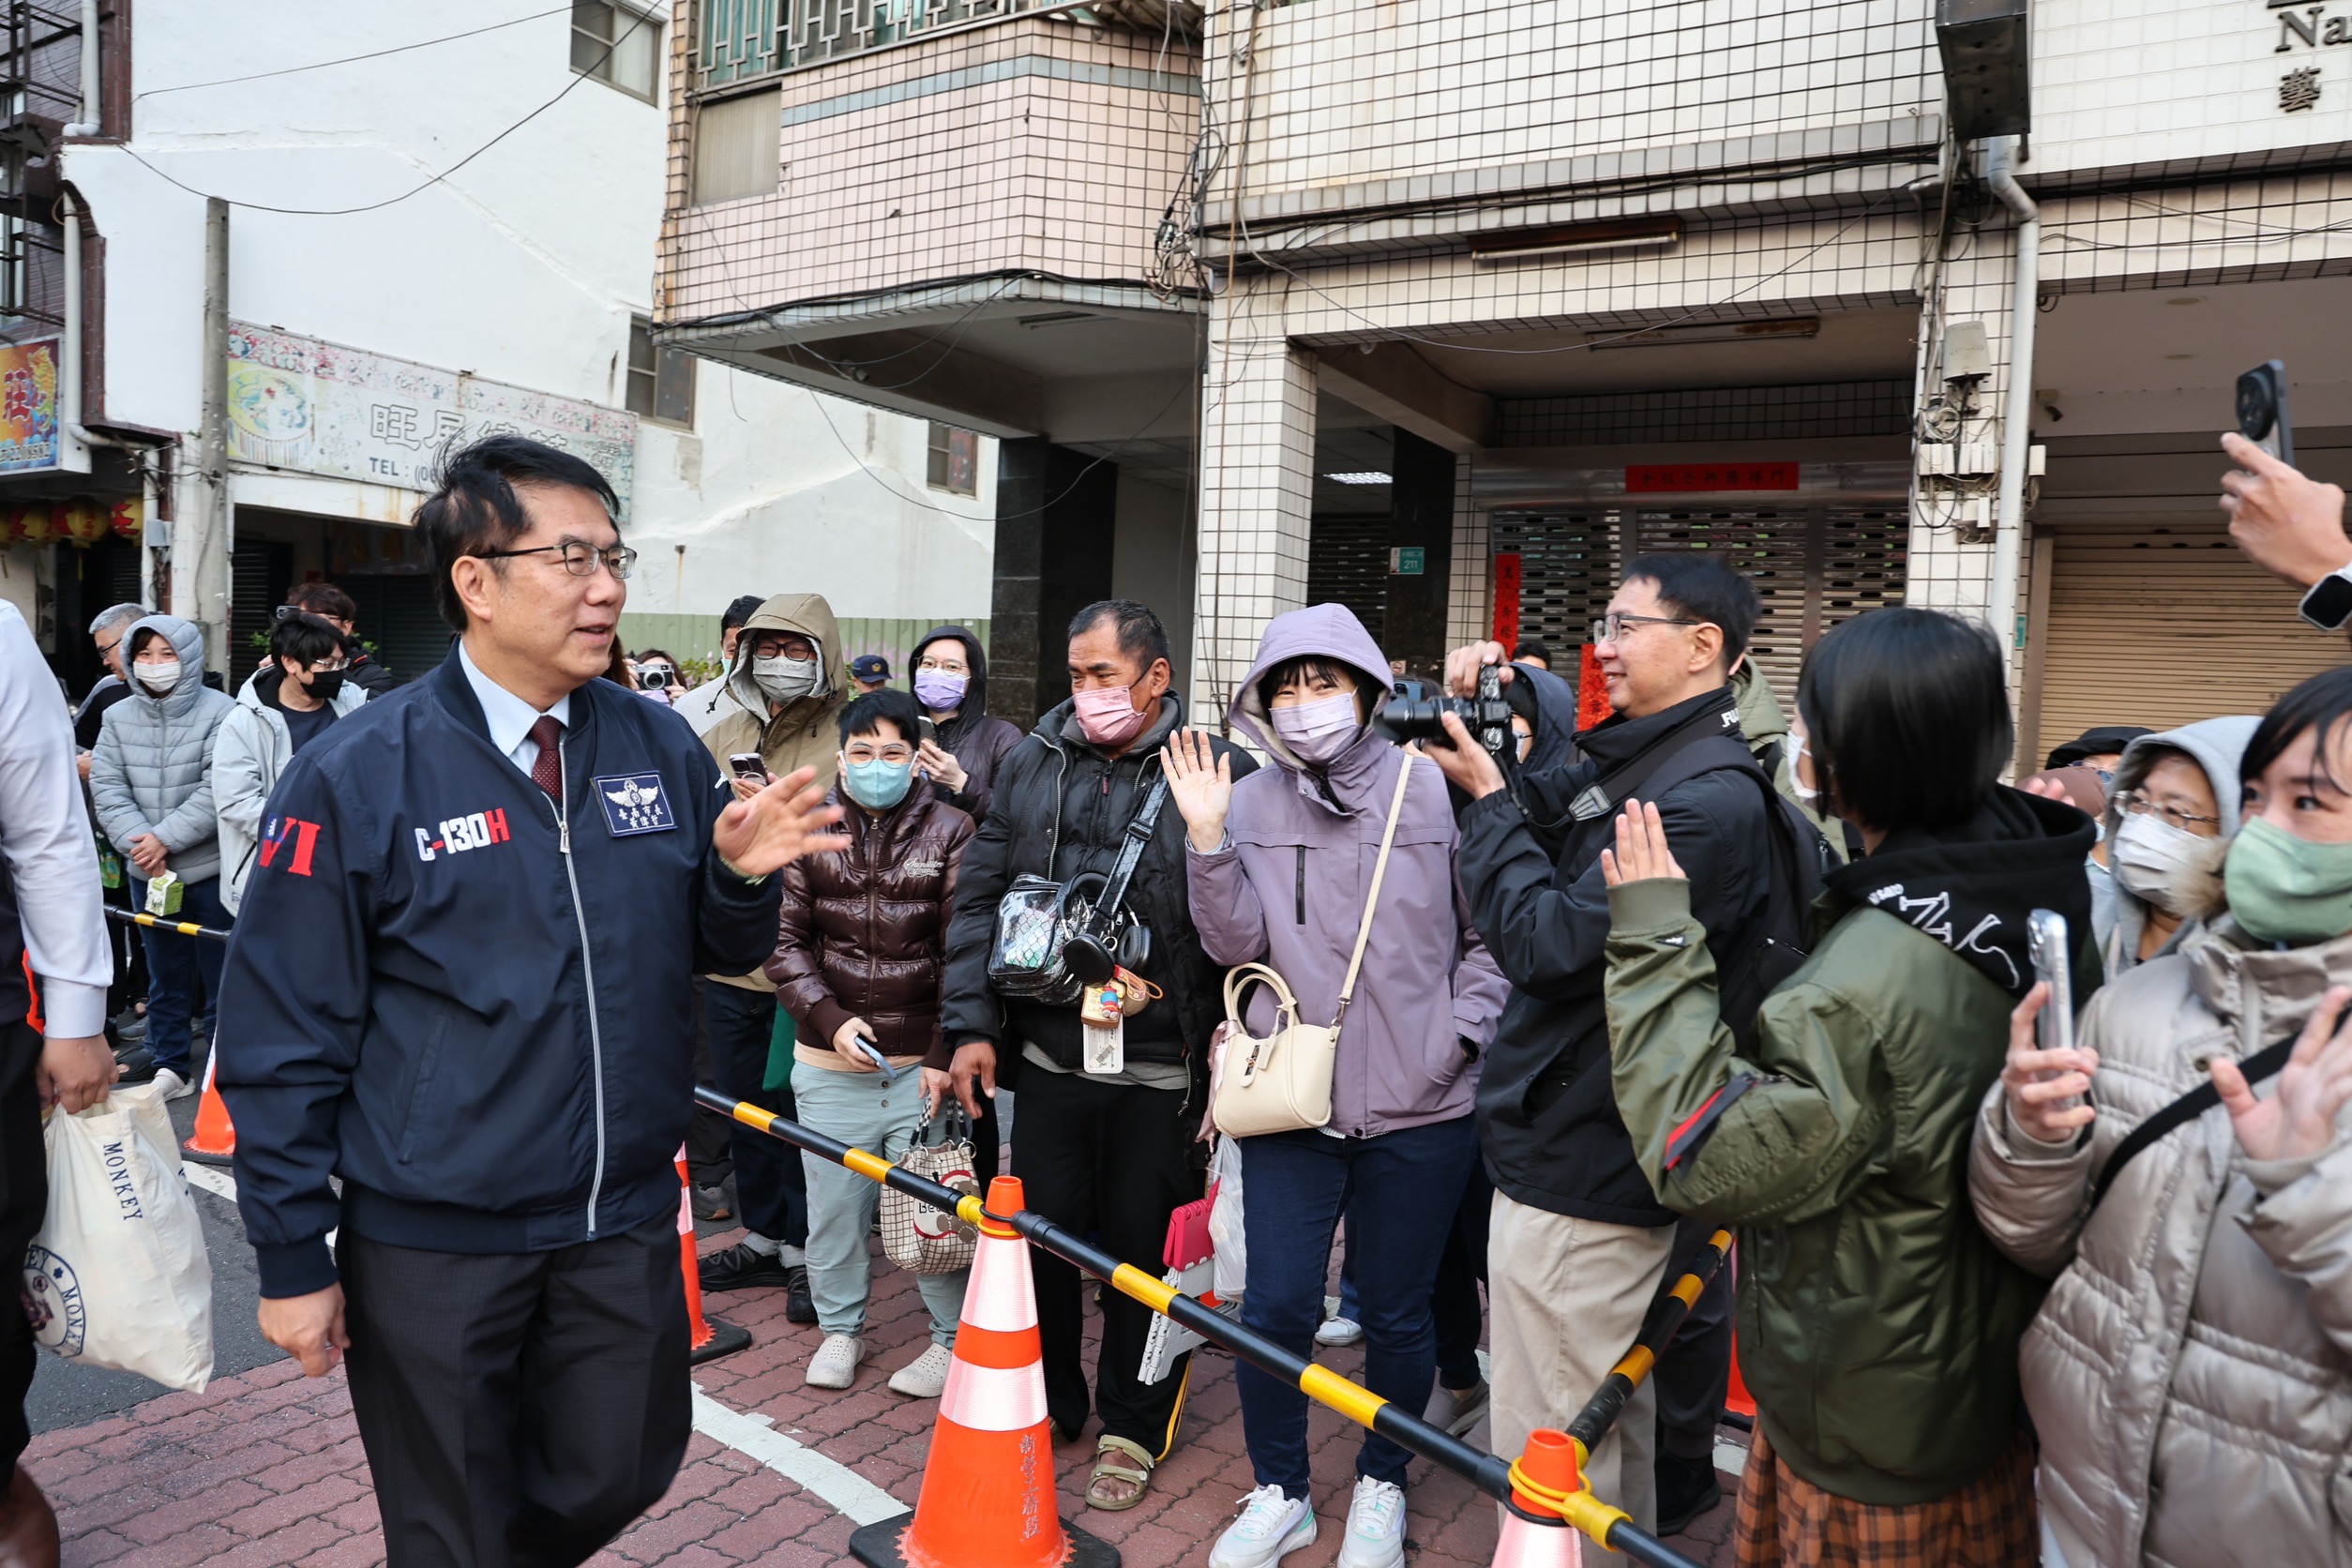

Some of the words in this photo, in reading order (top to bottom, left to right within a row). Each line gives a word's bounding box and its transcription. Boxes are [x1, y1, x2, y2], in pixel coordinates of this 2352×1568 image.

[1404, 559, 1419, 569] 211
[415, 807, 510, 862] C-130H
[103, 1141, 143, 1221] MONKEY
